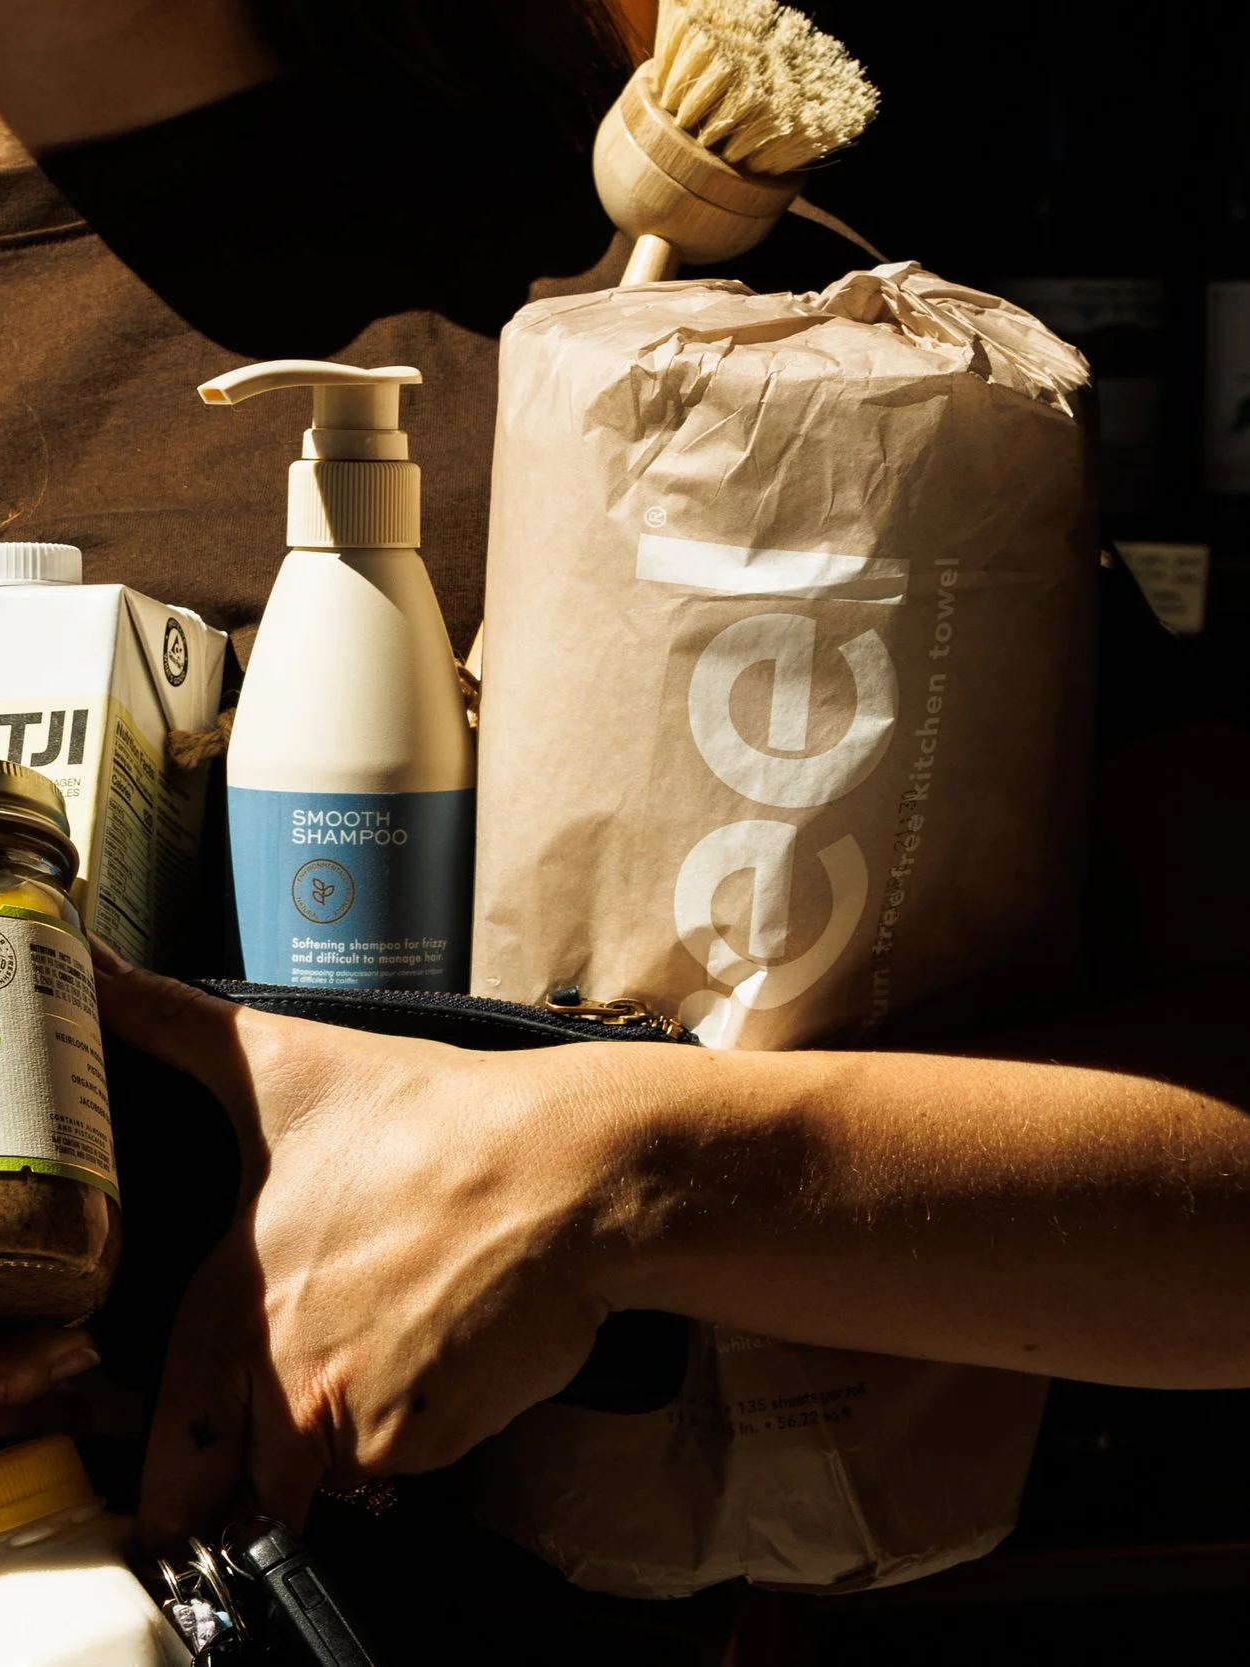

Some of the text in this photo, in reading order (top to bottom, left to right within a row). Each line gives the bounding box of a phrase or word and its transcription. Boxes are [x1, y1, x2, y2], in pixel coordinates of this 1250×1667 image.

[889, 814, 925, 880] free
[909, 673, 947, 800] kitchen
[929, 558, 960, 660] towel
[291, 810, 391, 827] SMOOTH
[291, 829, 409, 846] SHAMPOO
[291, 937, 447, 953] Softening shampoo for frizzy
[291, 952, 313, 963] and
[317, 952, 360, 964] difficult
[363, 953, 374, 964] to
[378, 955, 421, 966] manage
[739, 1399, 766, 1414] 135
